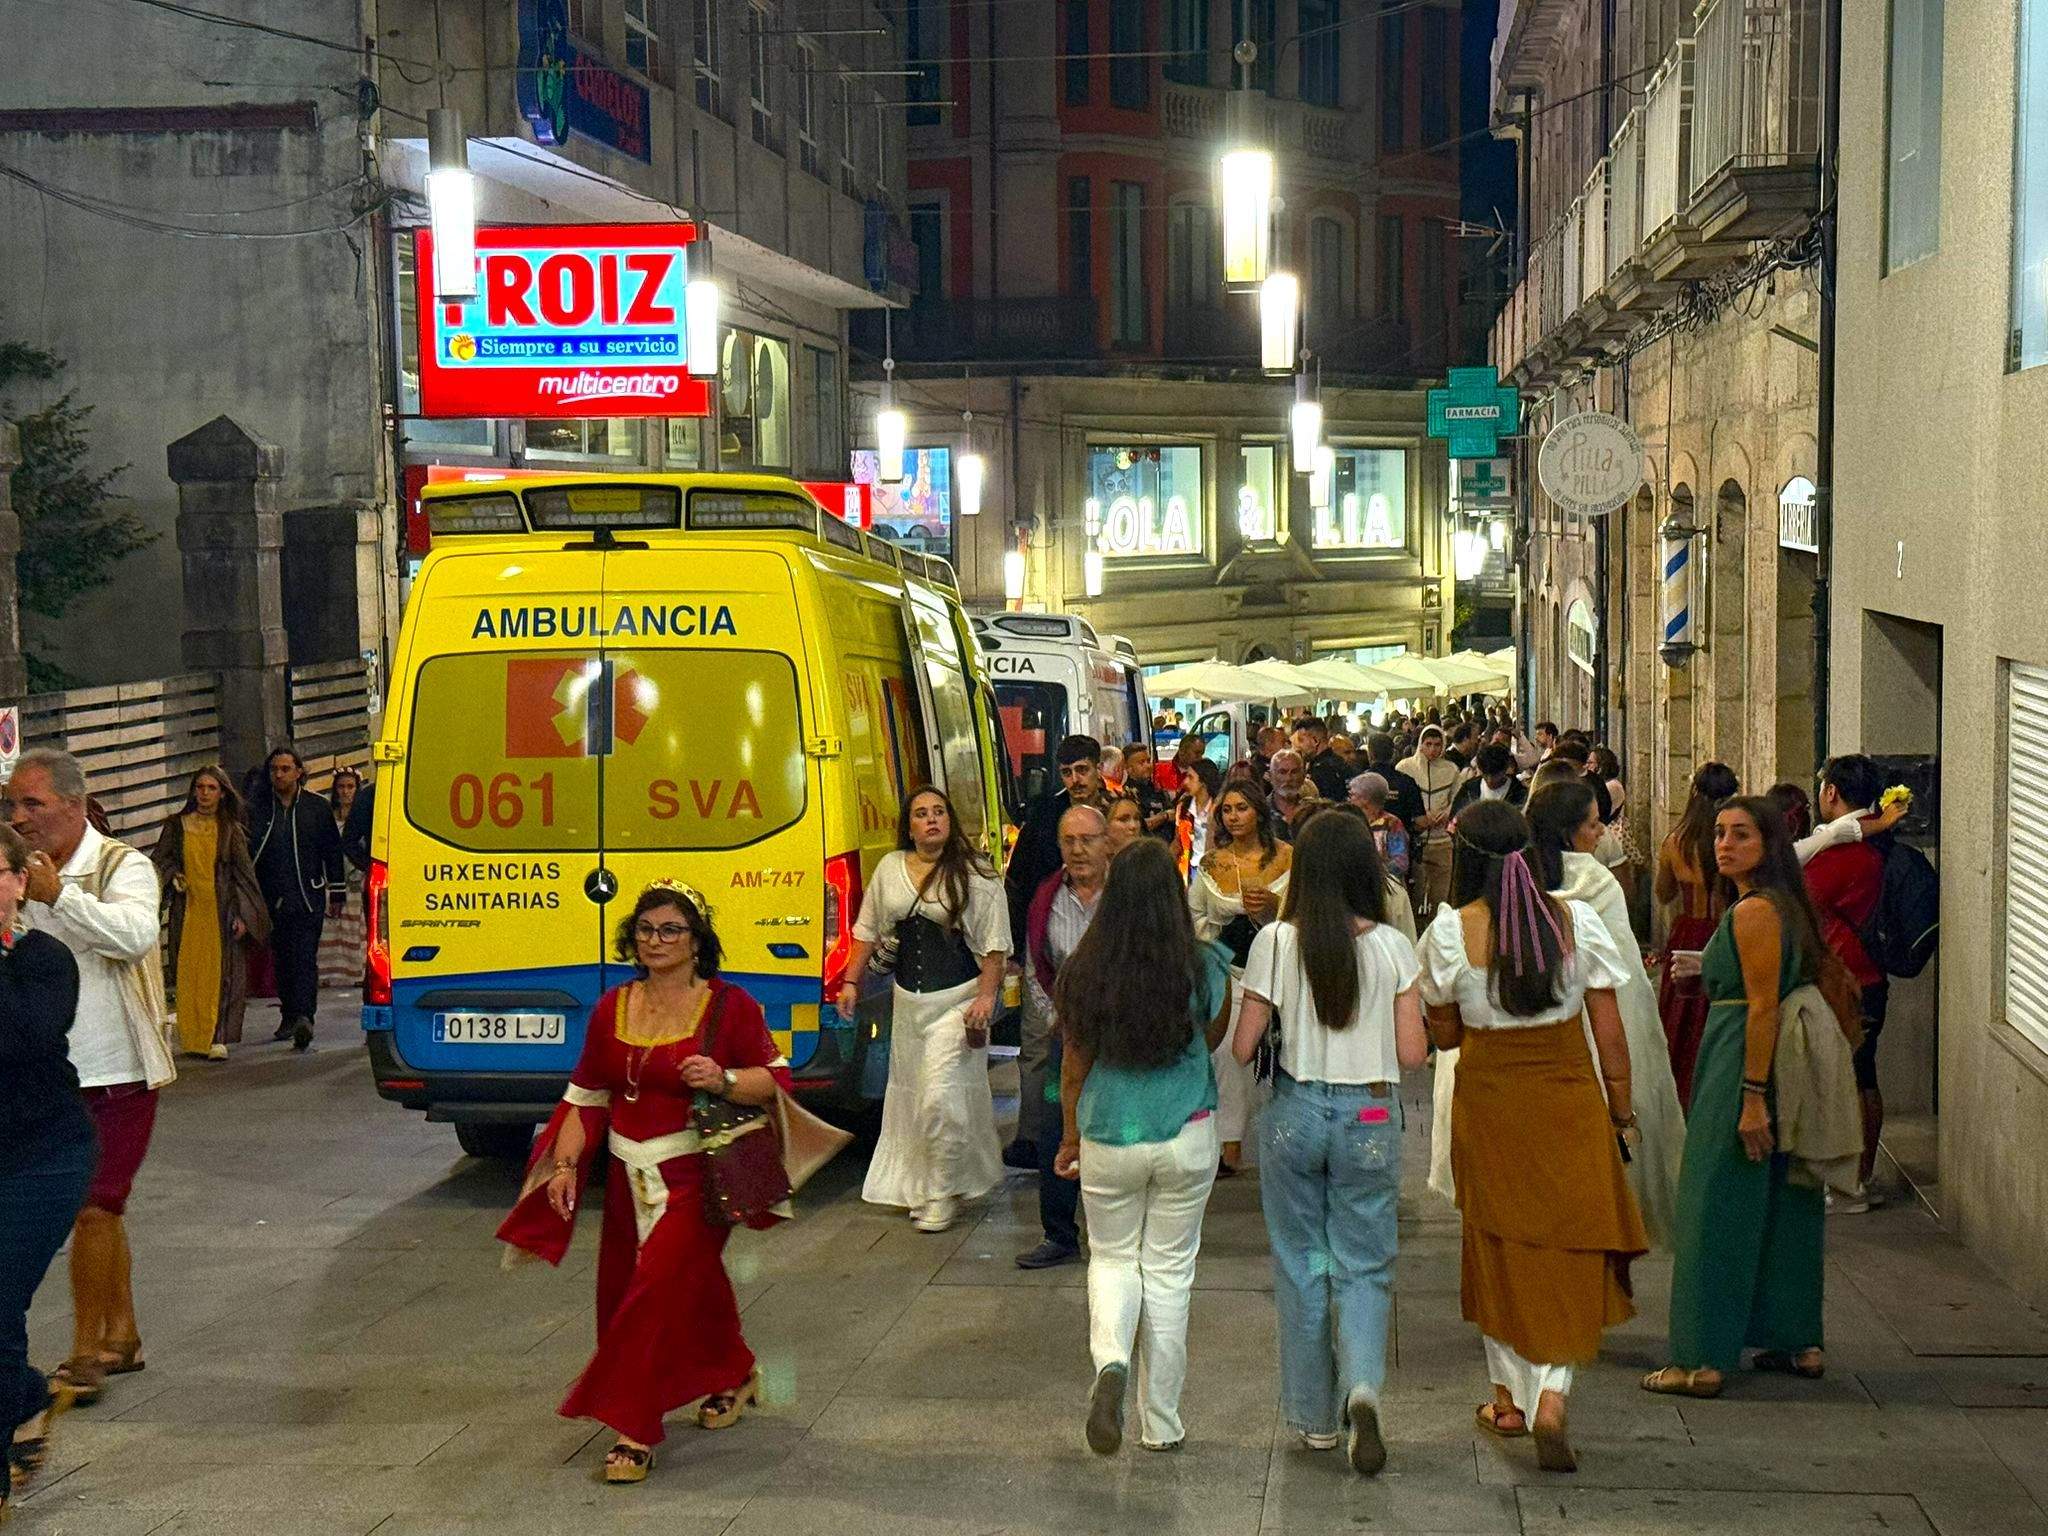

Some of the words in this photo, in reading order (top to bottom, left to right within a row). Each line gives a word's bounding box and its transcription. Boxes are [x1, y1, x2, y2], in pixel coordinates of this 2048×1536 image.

[445, 254, 676, 327] ROIZ
[481, 338, 555, 357] Siempre
[562, 342, 573, 354] a
[579, 342, 600, 354] su
[606, 338, 676, 354] servicio
[538, 371, 679, 395] multicentro
[1446, 407, 1498, 418] FARMACIA
[471, 605, 737, 639] AMBULANCIA
[449, 771, 554, 829] 061
[647, 778, 763, 820] SVA
[423, 862, 561, 882] URXENCIAS
[730, 870, 806, 888] AM-747
[425, 891, 560, 911] SANITARIAS
[400, 919, 481, 929] SPRINTER
[449, 1017, 507, 1039] 0138
[516, 1017, 560, 1039] LJJ
